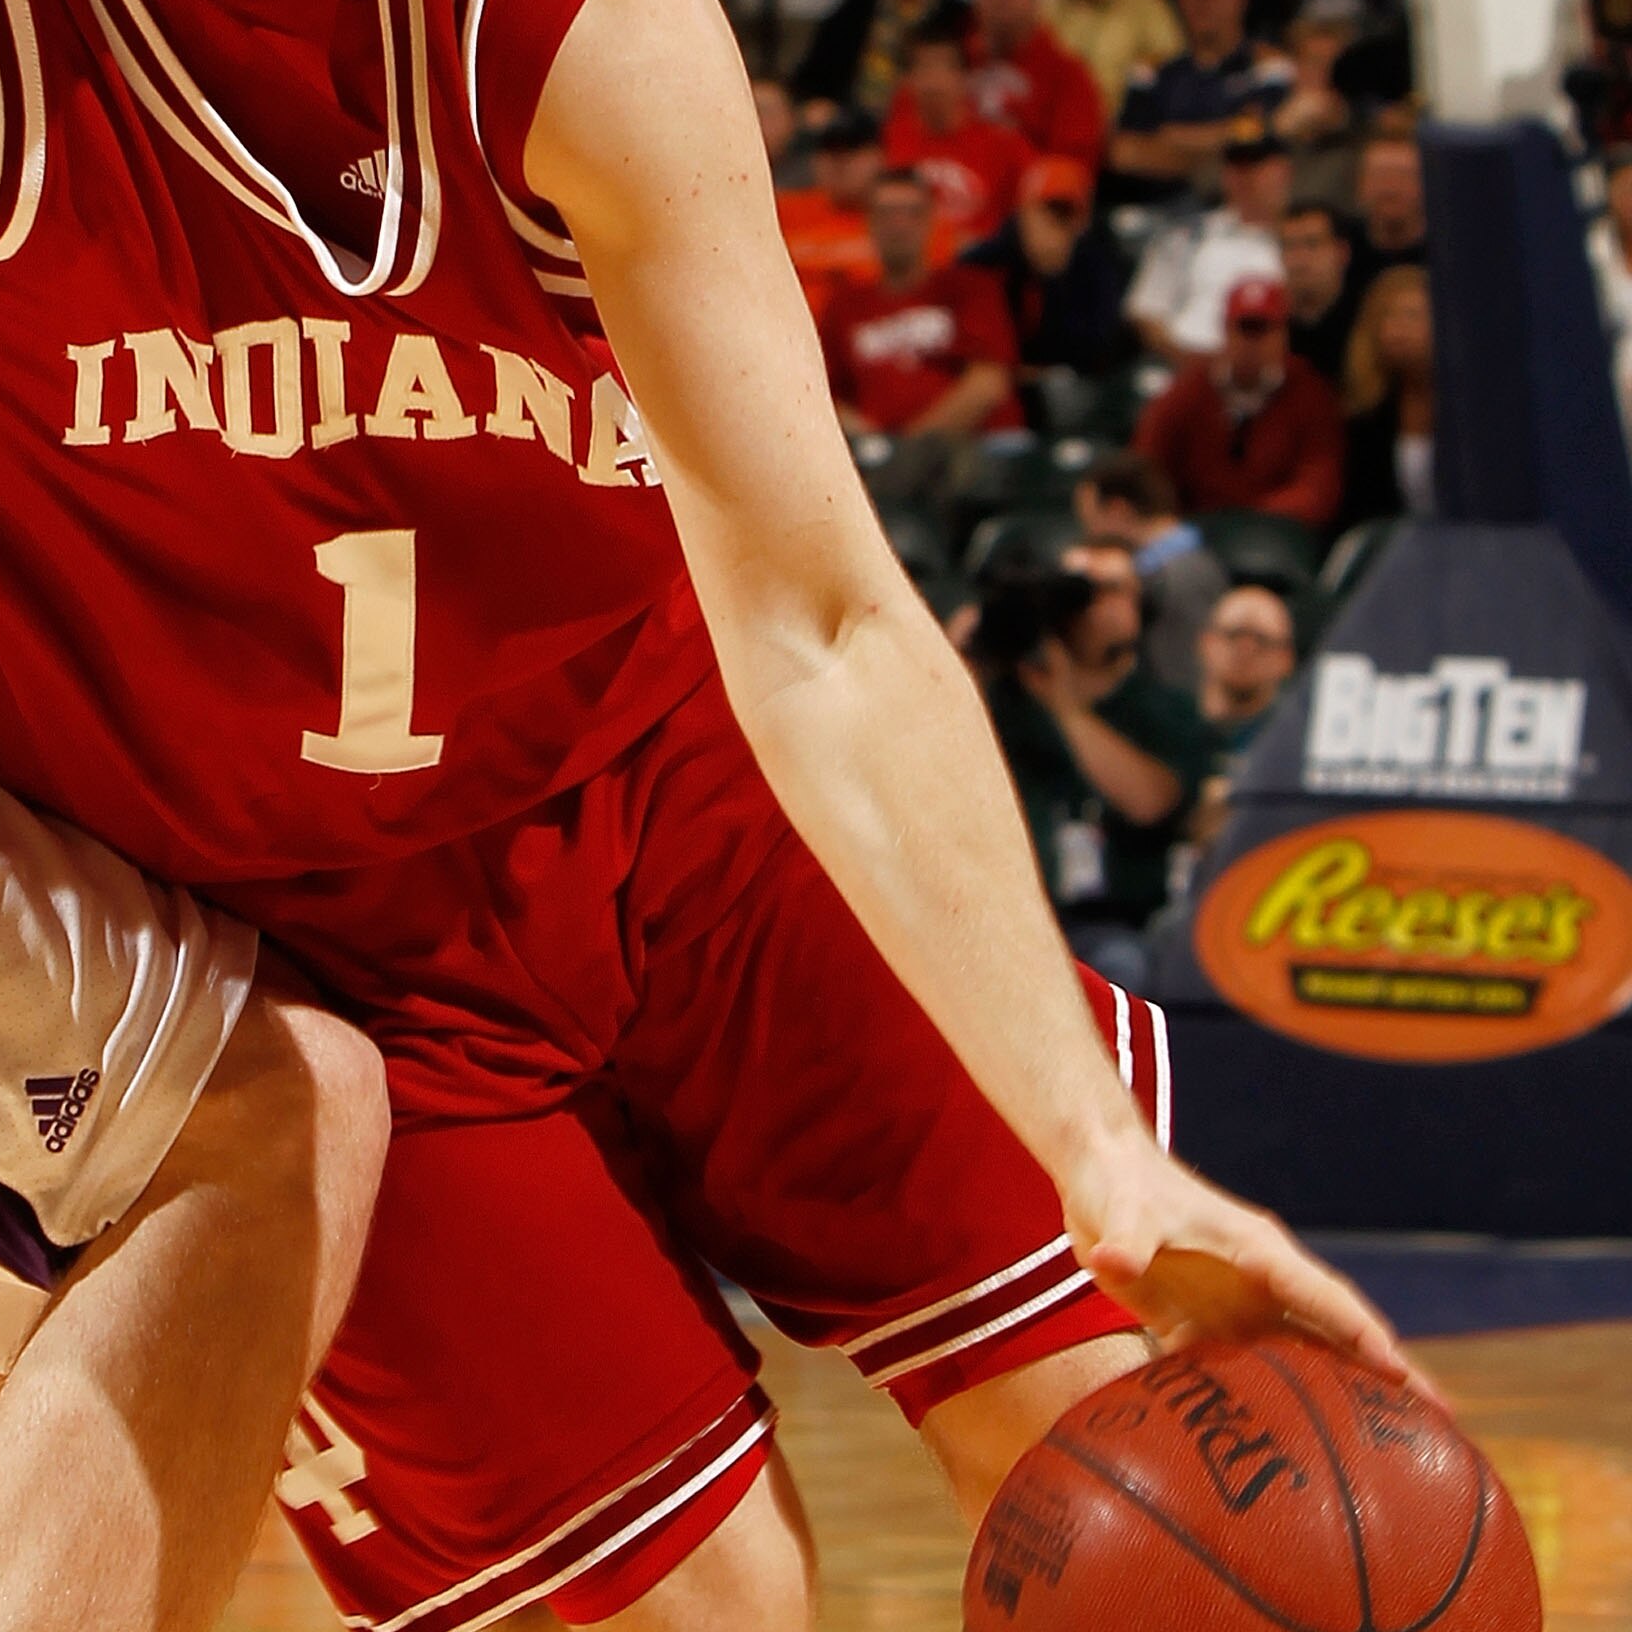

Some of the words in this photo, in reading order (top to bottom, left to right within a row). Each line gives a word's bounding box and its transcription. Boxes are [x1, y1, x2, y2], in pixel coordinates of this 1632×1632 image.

[63, 316, 664, 488] INDIANA
[300, 528, 445, 773] 1
[45, 1068, 100, 1153] adidas
